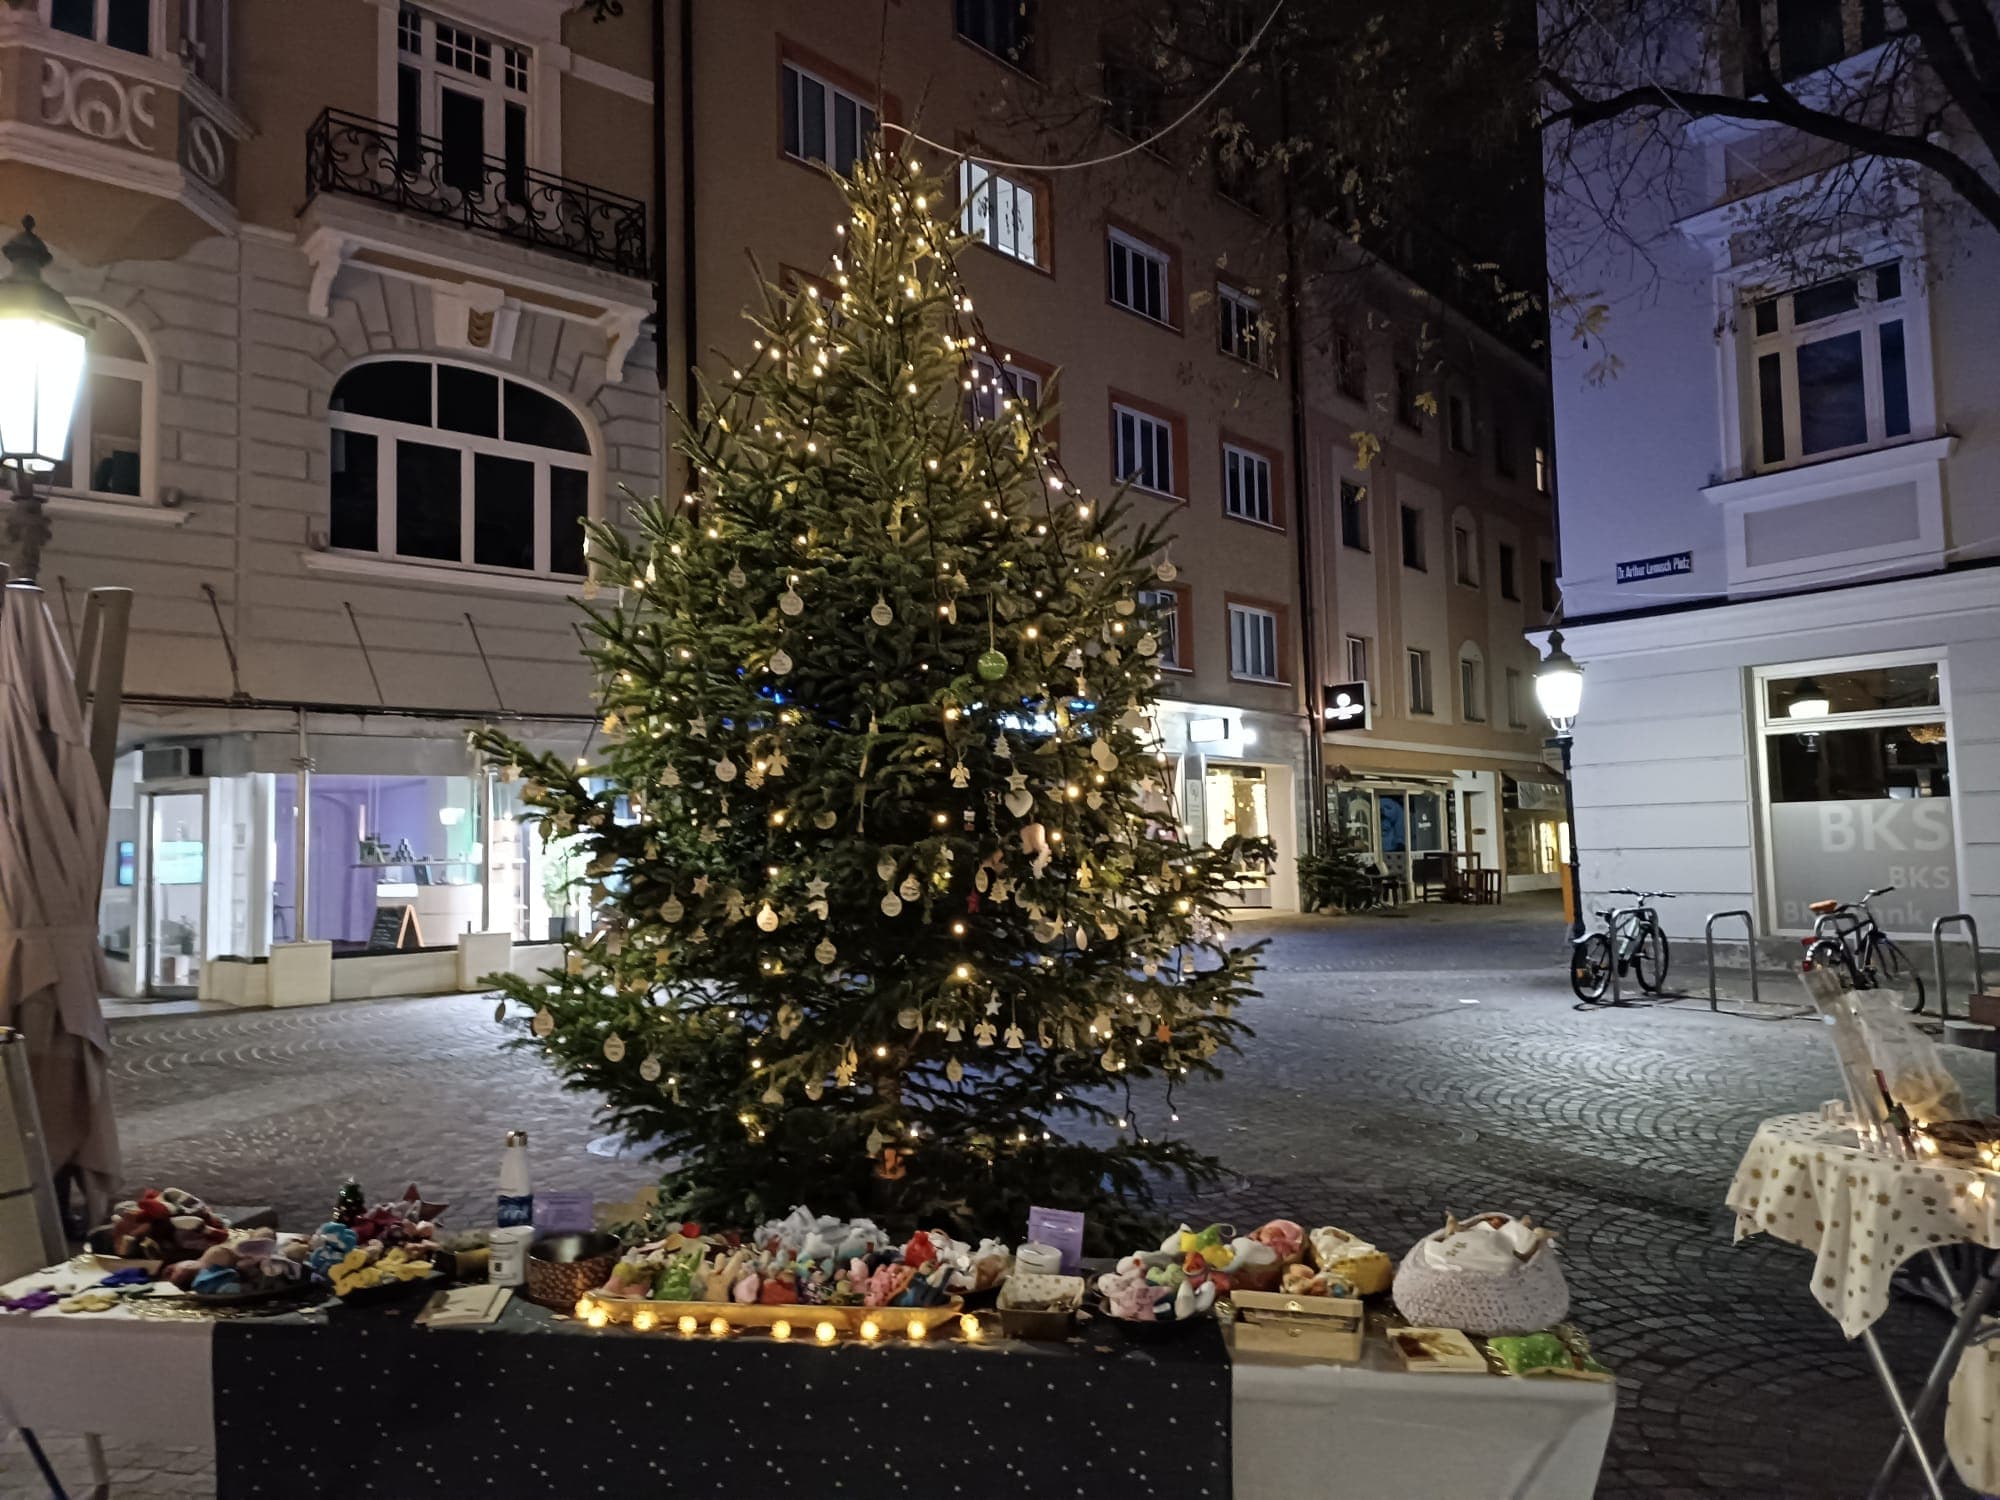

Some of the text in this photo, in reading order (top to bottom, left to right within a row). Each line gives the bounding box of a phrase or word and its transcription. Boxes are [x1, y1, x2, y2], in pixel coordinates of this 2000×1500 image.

[1626, 564, 1645, 577] Arthur
[1673, 557, 1690, 569] Platz
[1821, 803, 1950, 852] BKS
[1890, 867, 1949, 889] BKS
